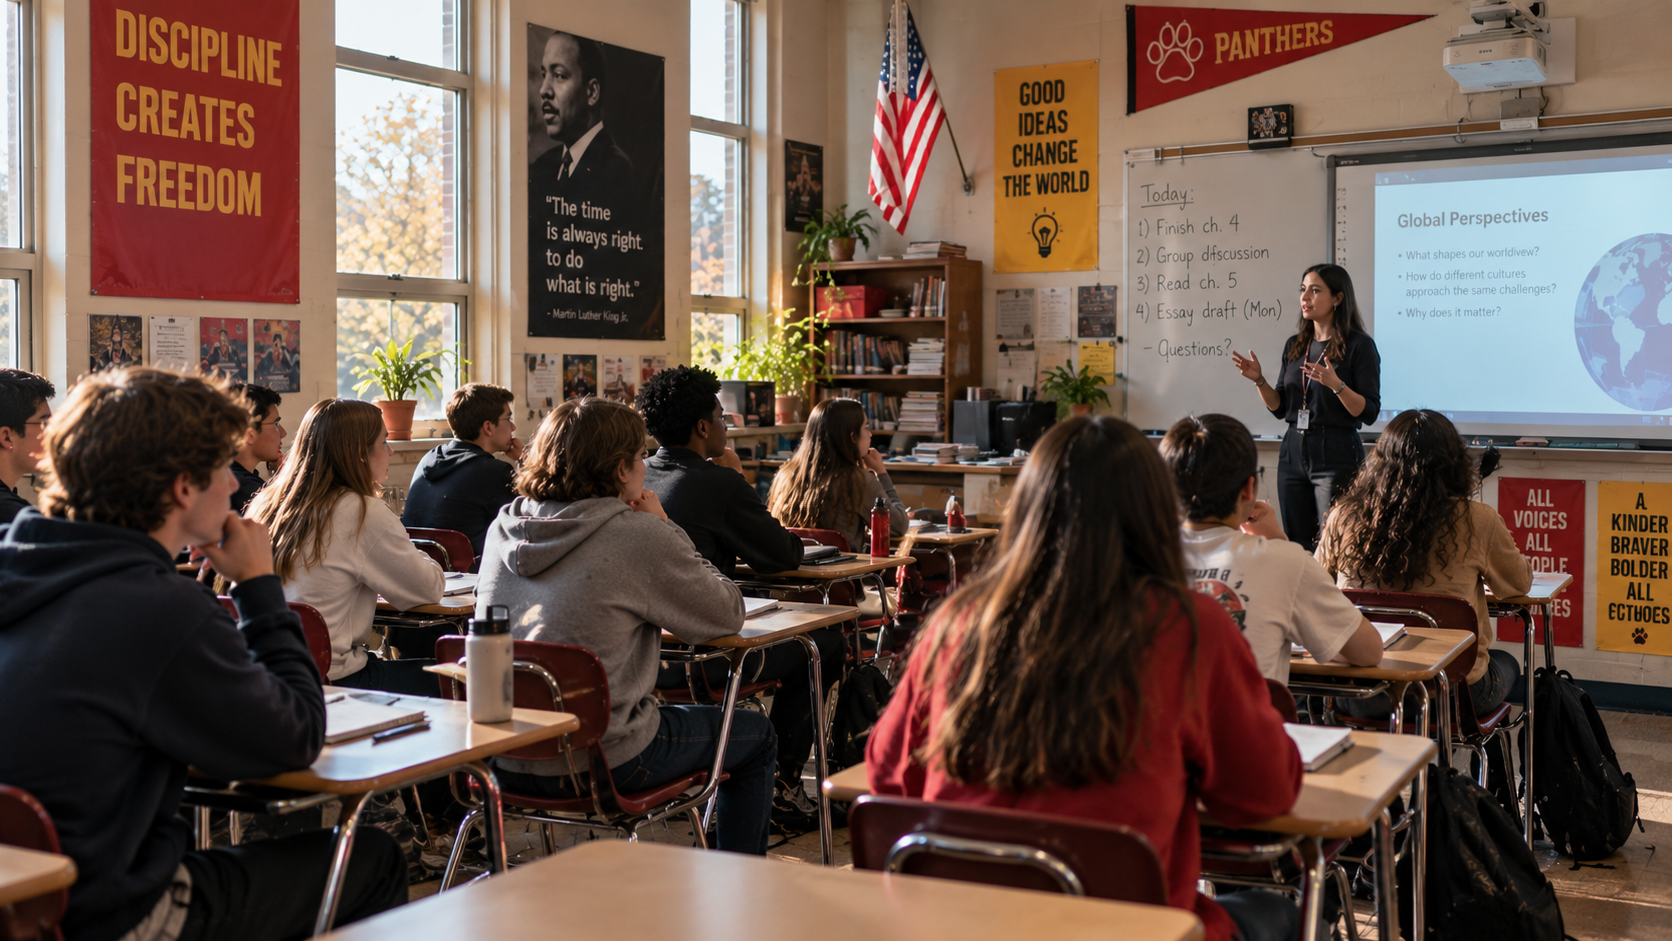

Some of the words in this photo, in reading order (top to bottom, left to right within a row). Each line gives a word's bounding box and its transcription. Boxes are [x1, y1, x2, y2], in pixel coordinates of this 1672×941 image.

[116, 8, 282, 87] DISCIPLINE
[1214, 20, 1333, 64] PANTHERS
[1020, 79, 1064, 106] GOOD
[117, 82, 255, 149] CREATES
[1019, 110, 1067, 136] IDEAS
[1013, 140, 1077, 167] CHANGE
[117, 155, 261, 216] FREEDOM
[1003, 174, 1031, 197] THE
[1036, 170, 1089, 195] WORLD
[1140, 183, 1194, 211] Today:
[581, 201, 610, 220] time
[1398, 212, 1445, 228] Global
[1450, 208, 1548, 228] Perspectives
[547, 221, 558, 240] is
[562, 223, 608, 250] always
[1139, 218, 1149, 239] 1)
[1157, 218, 1194, 235] Finish
[1202, 216, 1223, 233] ch.
[1230, 214, 1239, 231] 4
[546, 249, 561, 266] to
[566, 249, 583, 268] do
[1137, 246, 1150, 266] 2)
[1157, 246, 1194, 270] Group
[1406, 250, 1430, 260] What
[1434, 249, 1466, 261] shapes
[1469, 250, 1484, 258] our
[547, 274, 581, 293] what
[586, 277, 595, 294] is
[1137, 274, 1149, 294] 3)
[1158, 273, 1190, 291] Read
[1200, 273, 1219, 289] ch.
[1229, 272, 1237, 288] 5
[1407, 271, 1427, 281] How
[1430, 270, 1441, 280] do
[1444, 269, 1484, 280] different
[1487, 268, 1526, 279] cultures
[1406, 285, 1450, 298] approach
[1454, 285, 1468, 295] the
[1472, 286, 1496, 295] same
[1500, 282, 1556, 296] challenges?
[553, 309, 576, 318] Martin
[578, 309, 602, 321] Luther
[1136, 302, 1149, 323] 4)
[1158, 303, 1193, 326] Essay
[1203, 300, 1236, 320] draft
[1244, 299, 1281, 321] (Mon)
[1406, 307, 1427, 320] Why
[1430, 307, 1452, 317] does
[1455, 307, 1461, 317] it
[1464, 305, 1501, 316] matter?
[1158, 338, 1232, 363] Questions?
[1527, 489, 1554, 507] ALL
[1514, 510, 1567, 529] VOICES
[1612, 514, 1668, 533] KINDER
[1526, 533, 1552, 552] ALL
[1611, 536, 1668, 556] BRAVER
[1523, 555, 1568, 574] OPLE
[1611, 559, 1668, 579] BOLDER
[1627, 582, 1654, 601] ALL
